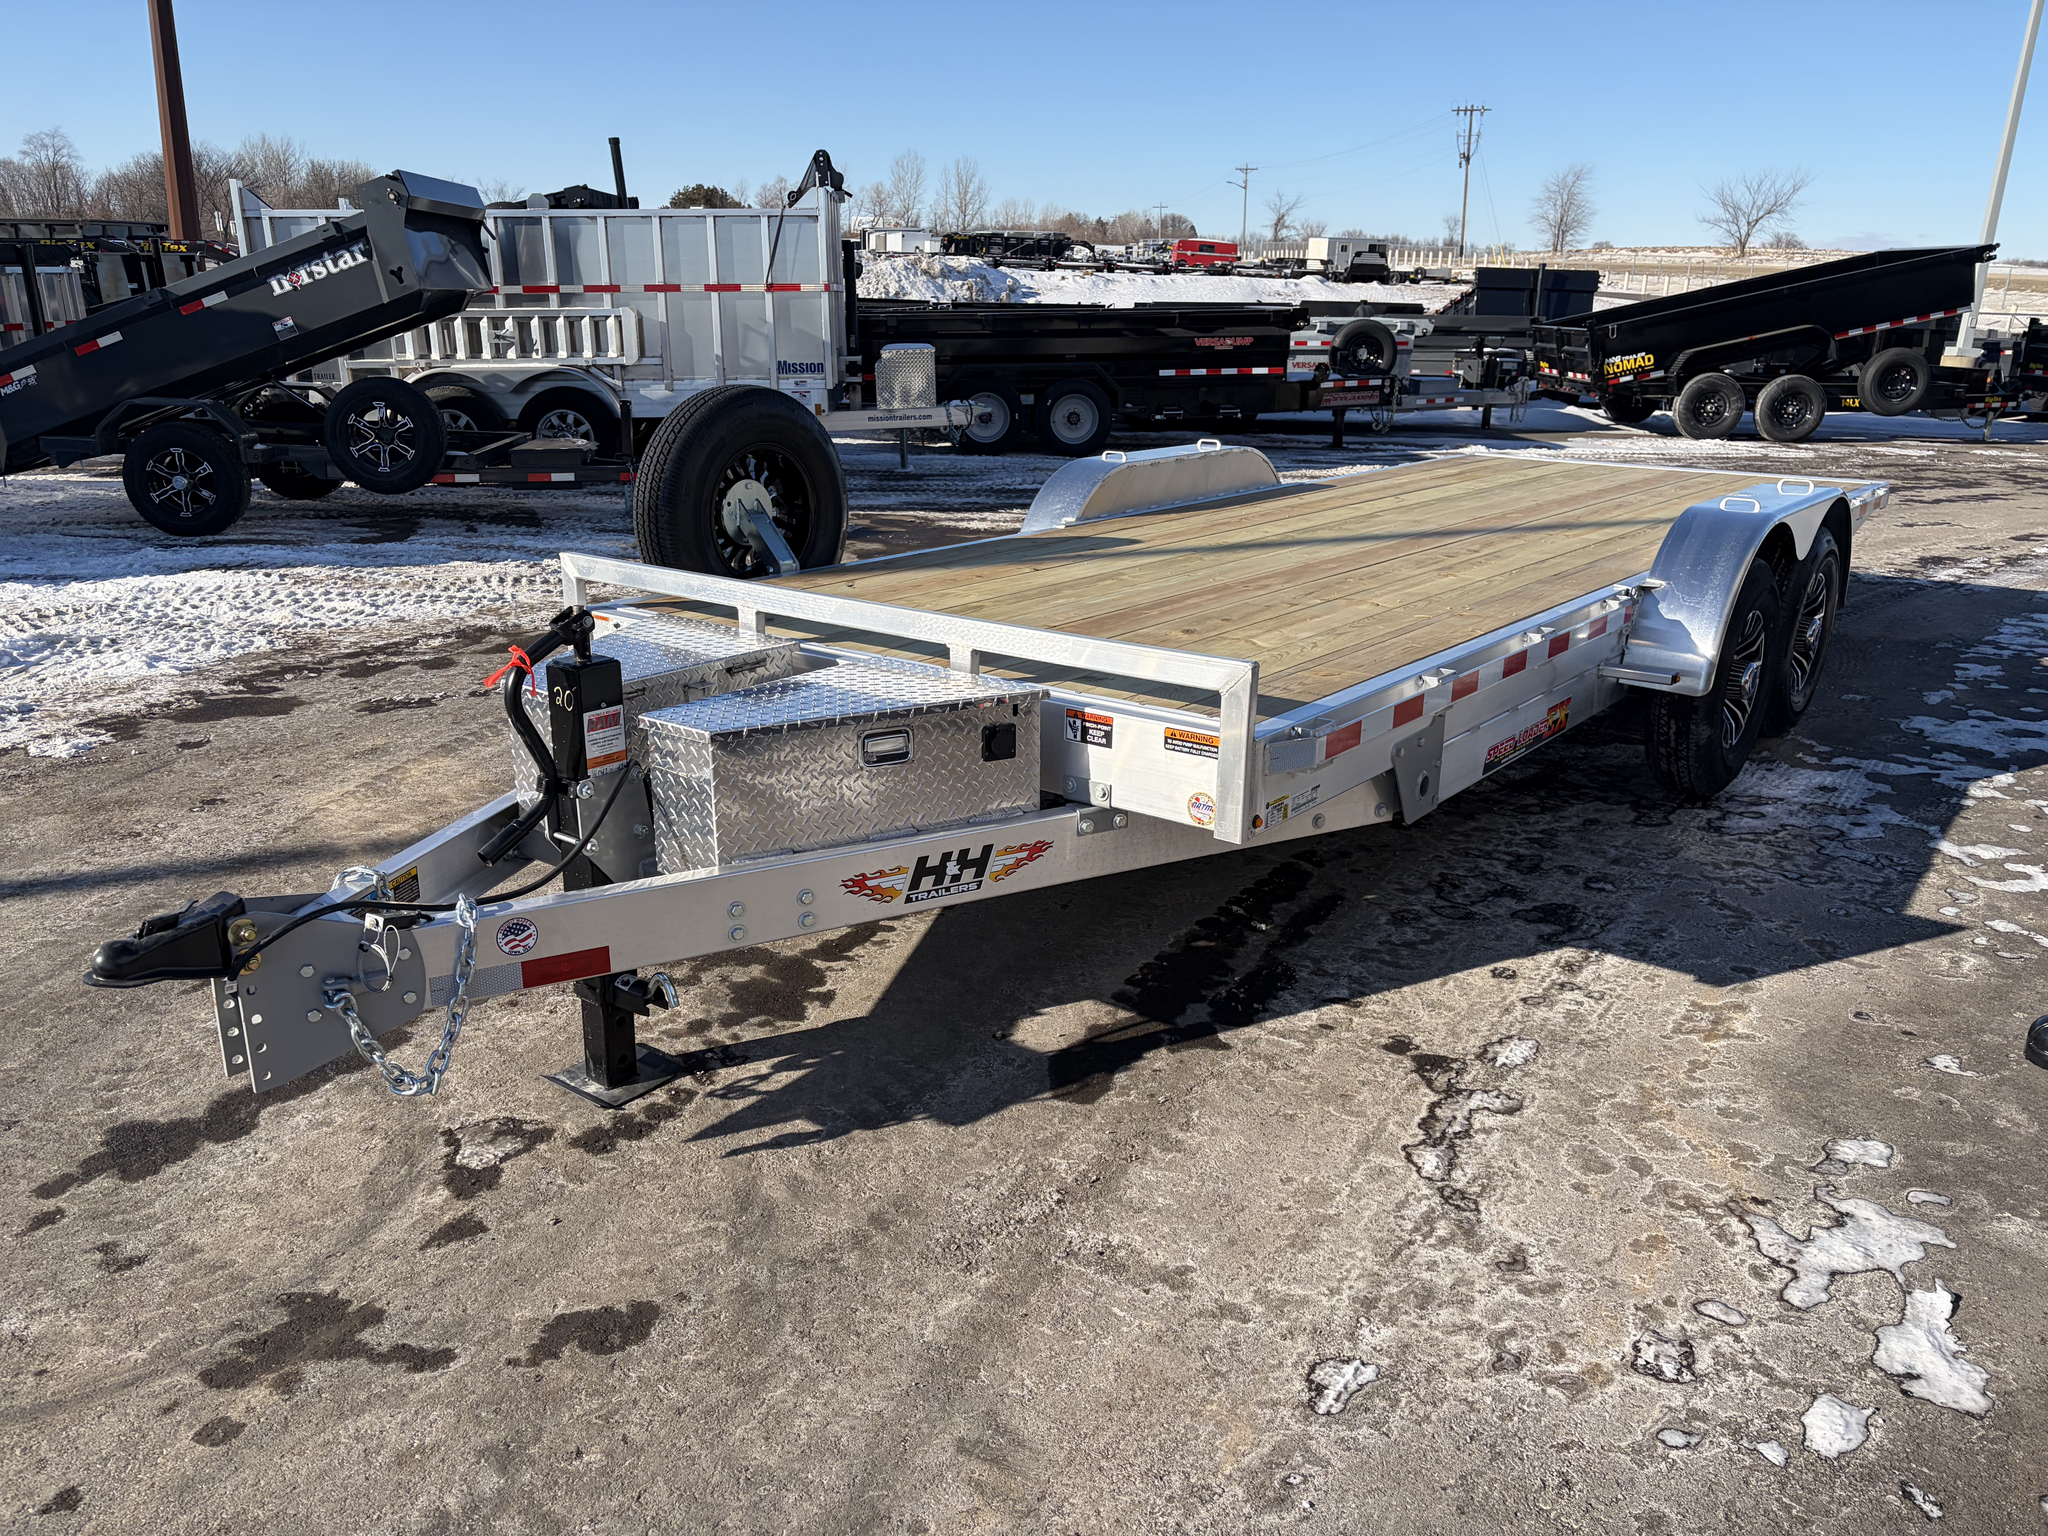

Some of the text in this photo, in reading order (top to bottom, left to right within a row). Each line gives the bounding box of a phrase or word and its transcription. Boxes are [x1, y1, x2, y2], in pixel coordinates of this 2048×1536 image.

[1194, 337, 1254, 346] VERSADUMP
[1622, 352, 1646, 360] TRAILER
[1603, 354, 1654, 375] NOMAD
[0, 380, 20, 397] M&G
[1841, 398, 1860, 408] 14LX
[867, 414, 933, 422] missiontrailers.com
[587, 714, 621, 733] RAM
[1081, 712, 1107, 723] WARNING
[1087, 735, 1106, 744] CLEAR
[1089, 729, 1105, 737] KEEP
[1178, 731, 1213, 744] WARNING
[1485, 735, 1517, 763] SPEED
[1516, 718, 1550, 746] LOADER
[908, 843, 994, 892] H&H
[391, 871, 412, 887] CAUTION
[909, 881, 978, 902] TRAILERS
